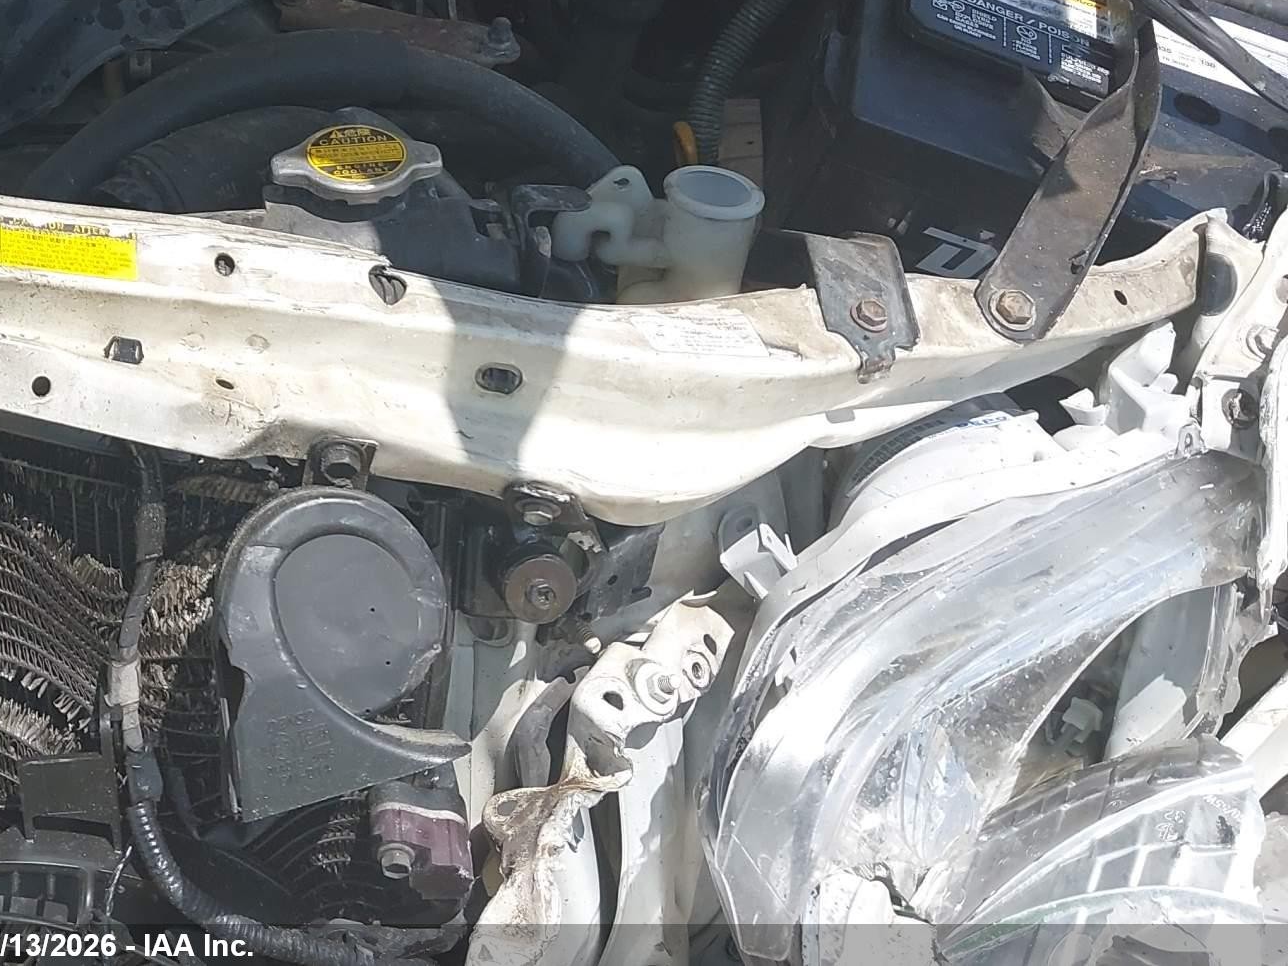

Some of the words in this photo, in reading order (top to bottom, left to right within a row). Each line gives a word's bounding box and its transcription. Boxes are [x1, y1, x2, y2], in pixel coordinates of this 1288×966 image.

[1039, 21, 1090, 46] POISON
[319, 135, 387, 145] CAUTION
[336, 162, 384, 170] ENGINE
